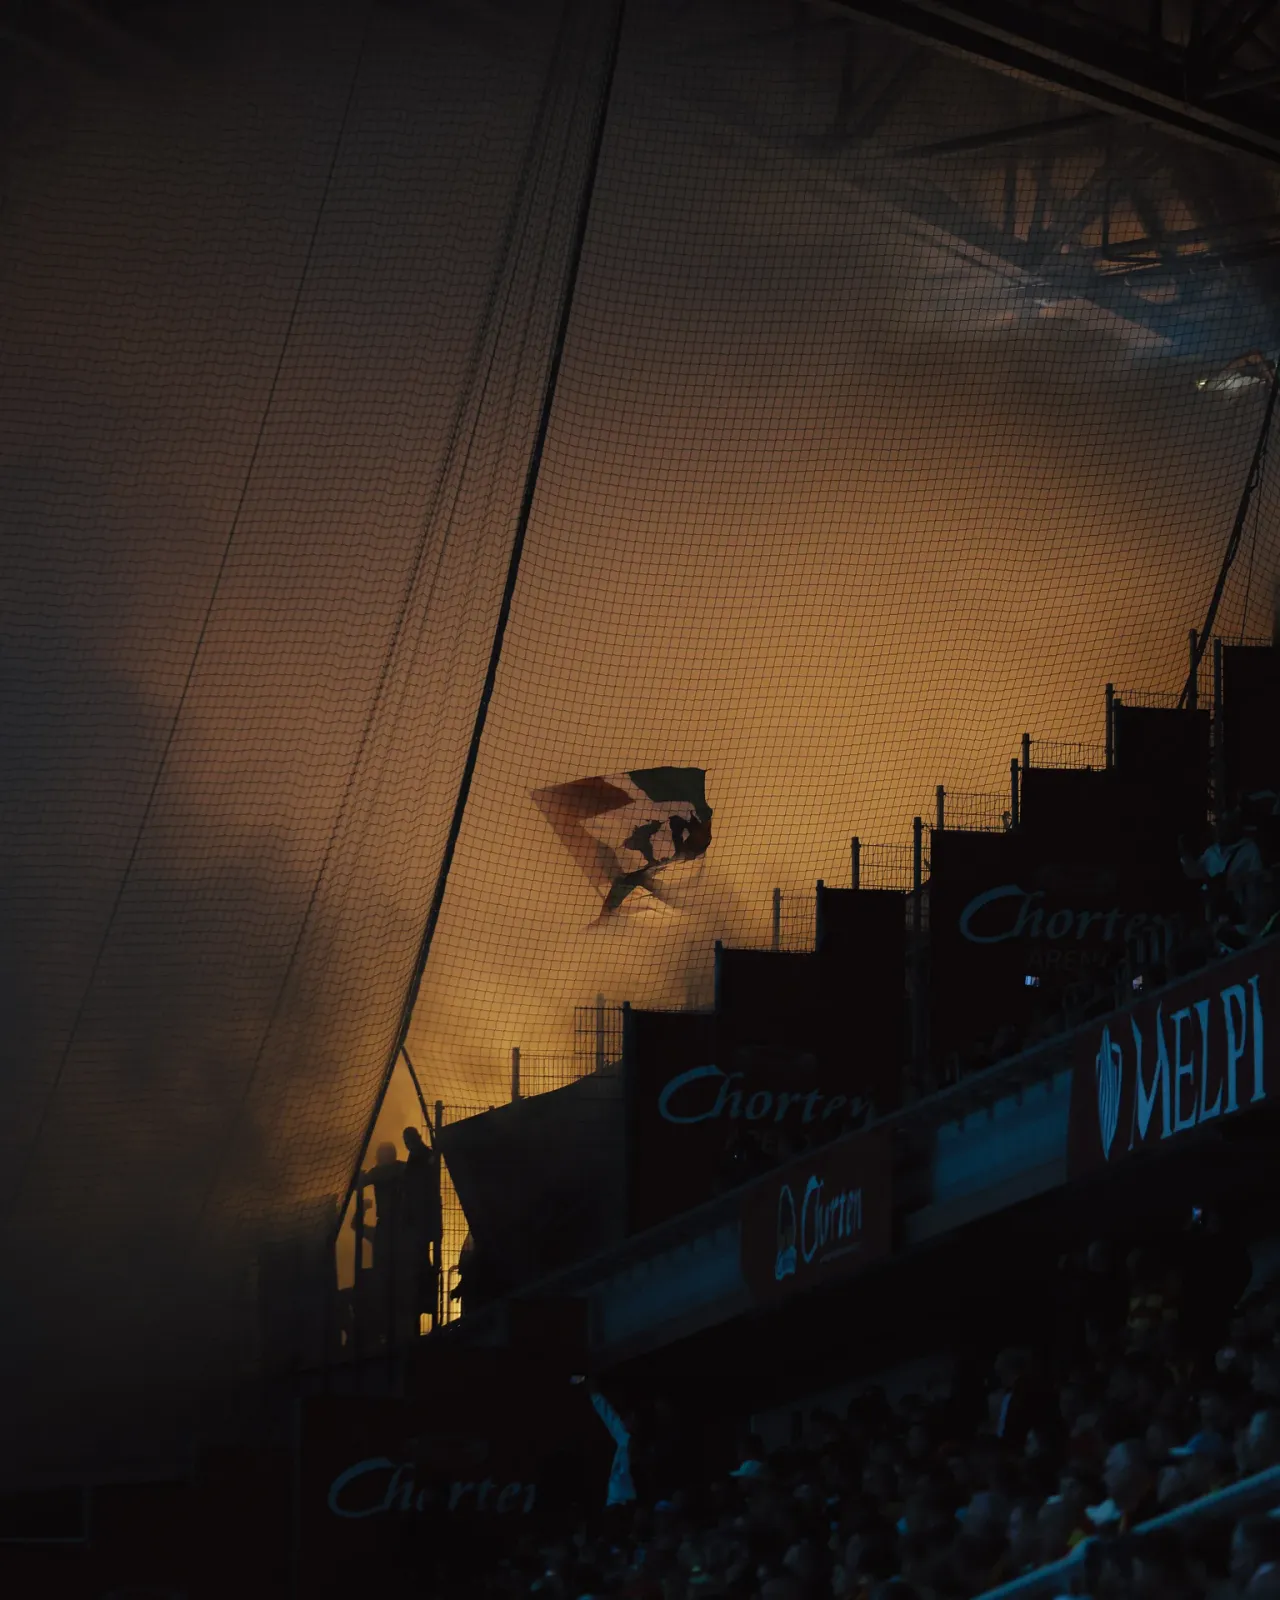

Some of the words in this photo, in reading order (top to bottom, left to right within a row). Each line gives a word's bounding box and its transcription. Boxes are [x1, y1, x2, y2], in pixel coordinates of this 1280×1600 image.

[958, 882, 1177, 945] Chorte
[1127, 972, 1269, 1152] MELPI
[327, 1455, 539, 1519] Chrte
